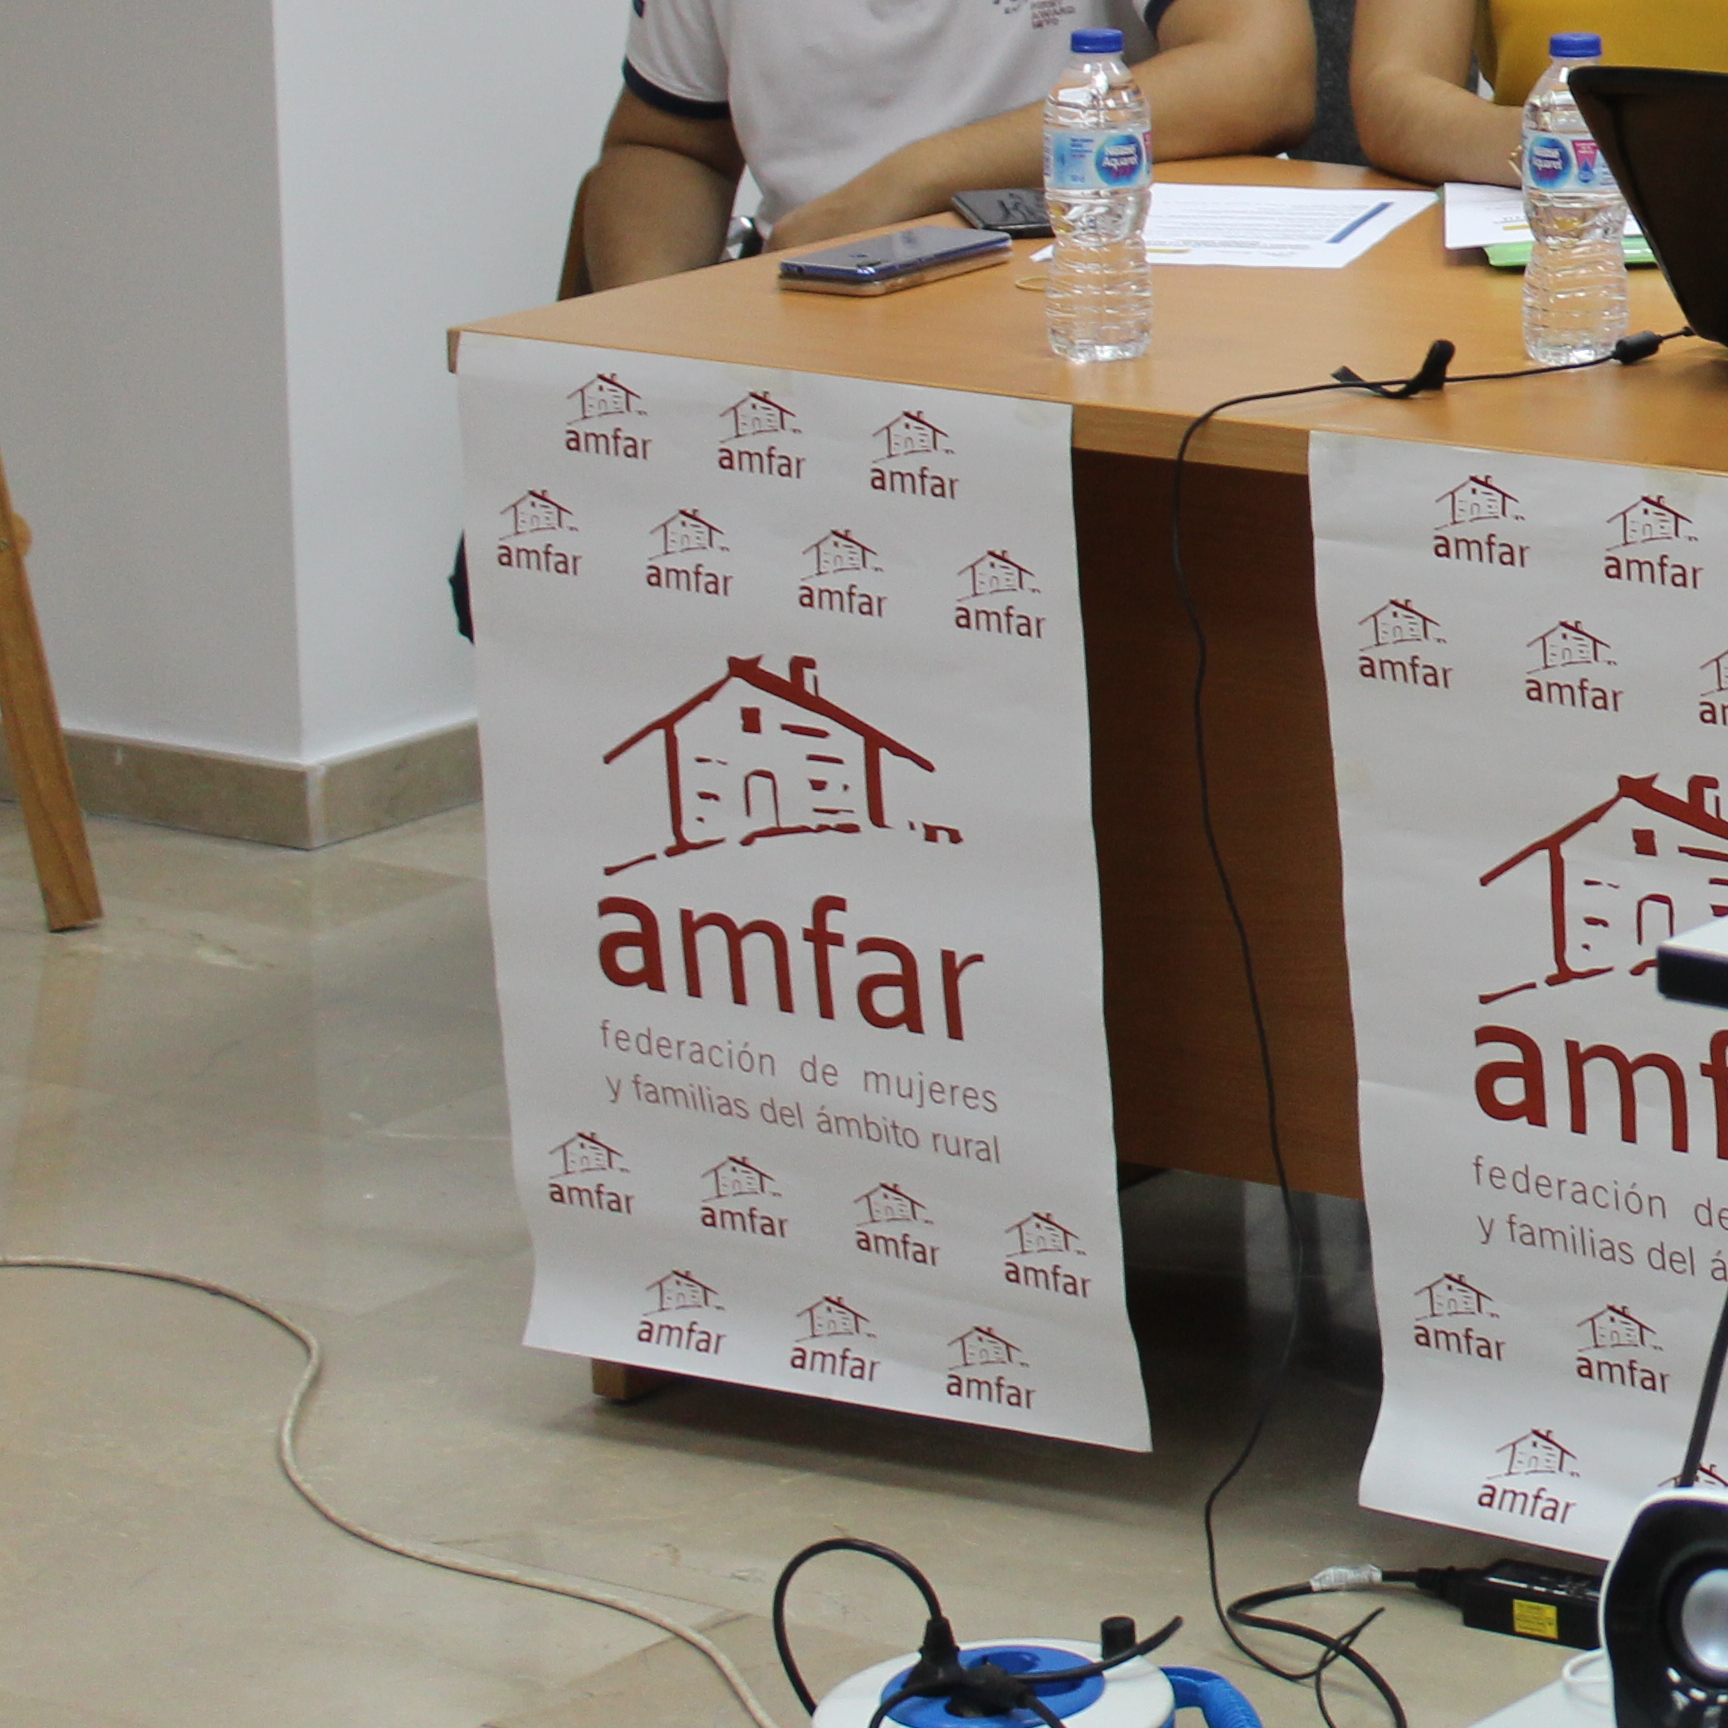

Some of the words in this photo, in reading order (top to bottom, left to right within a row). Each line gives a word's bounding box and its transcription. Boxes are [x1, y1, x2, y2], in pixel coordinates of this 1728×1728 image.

[566, 428, 651, 459] amfar
[718, 446, 805, 478] amfar
[871, 466, 958, 499] amfar
[498, 543, 581, 575] amfar
[1434, 533, 1529, 567] amfar
[646, 564, 732, 596] amfar
[1605, 554, 1702, 589] amfar
[799, 584, 886, 617] amfar
[955, 605, 1045, 638] amfar
[1359, 655, 1452, 688] amfar
[1526, 678, 1622, 712] amfar
[598, 895, 984, 1041] amfar
[600, 1019, 775, 1076] federación
[800, 1055, 838, 1087] de
[864, 1071, 998, 1113] mujeres
[606, 1076, 621, 1104] y
[632, 1074, 750, 1120] familias
[760, 1097, 804, 1129] del
[817, 1105, 920, 1149] ámbito
[932, 1133, 1000, 1164] rural
[549, 1183, 632, 1214] amfar
[1473, 1155, 1666, 1219] federación
[701, 1207, 787, 1237] amfar
[856, 1231, 939, 1266] amfar
[1478, 1216, 1494, 1245] y
[1507, 1214, 1634, 1265] familias
[1647, 1242, 1695, 1276] del
[1005, 1262, 1090, 1298] amfar
[637, 1320, 725, 1354] amfar
[1414, 1325, 1504, 1361] amfar
[790, 1347, 879, 1381] amfar
[1577, 1357, 1669, 1393] amfar
[947, 1374, 1035, 1409] amfar
[1478, 1484, 1574, 1523] amfar
